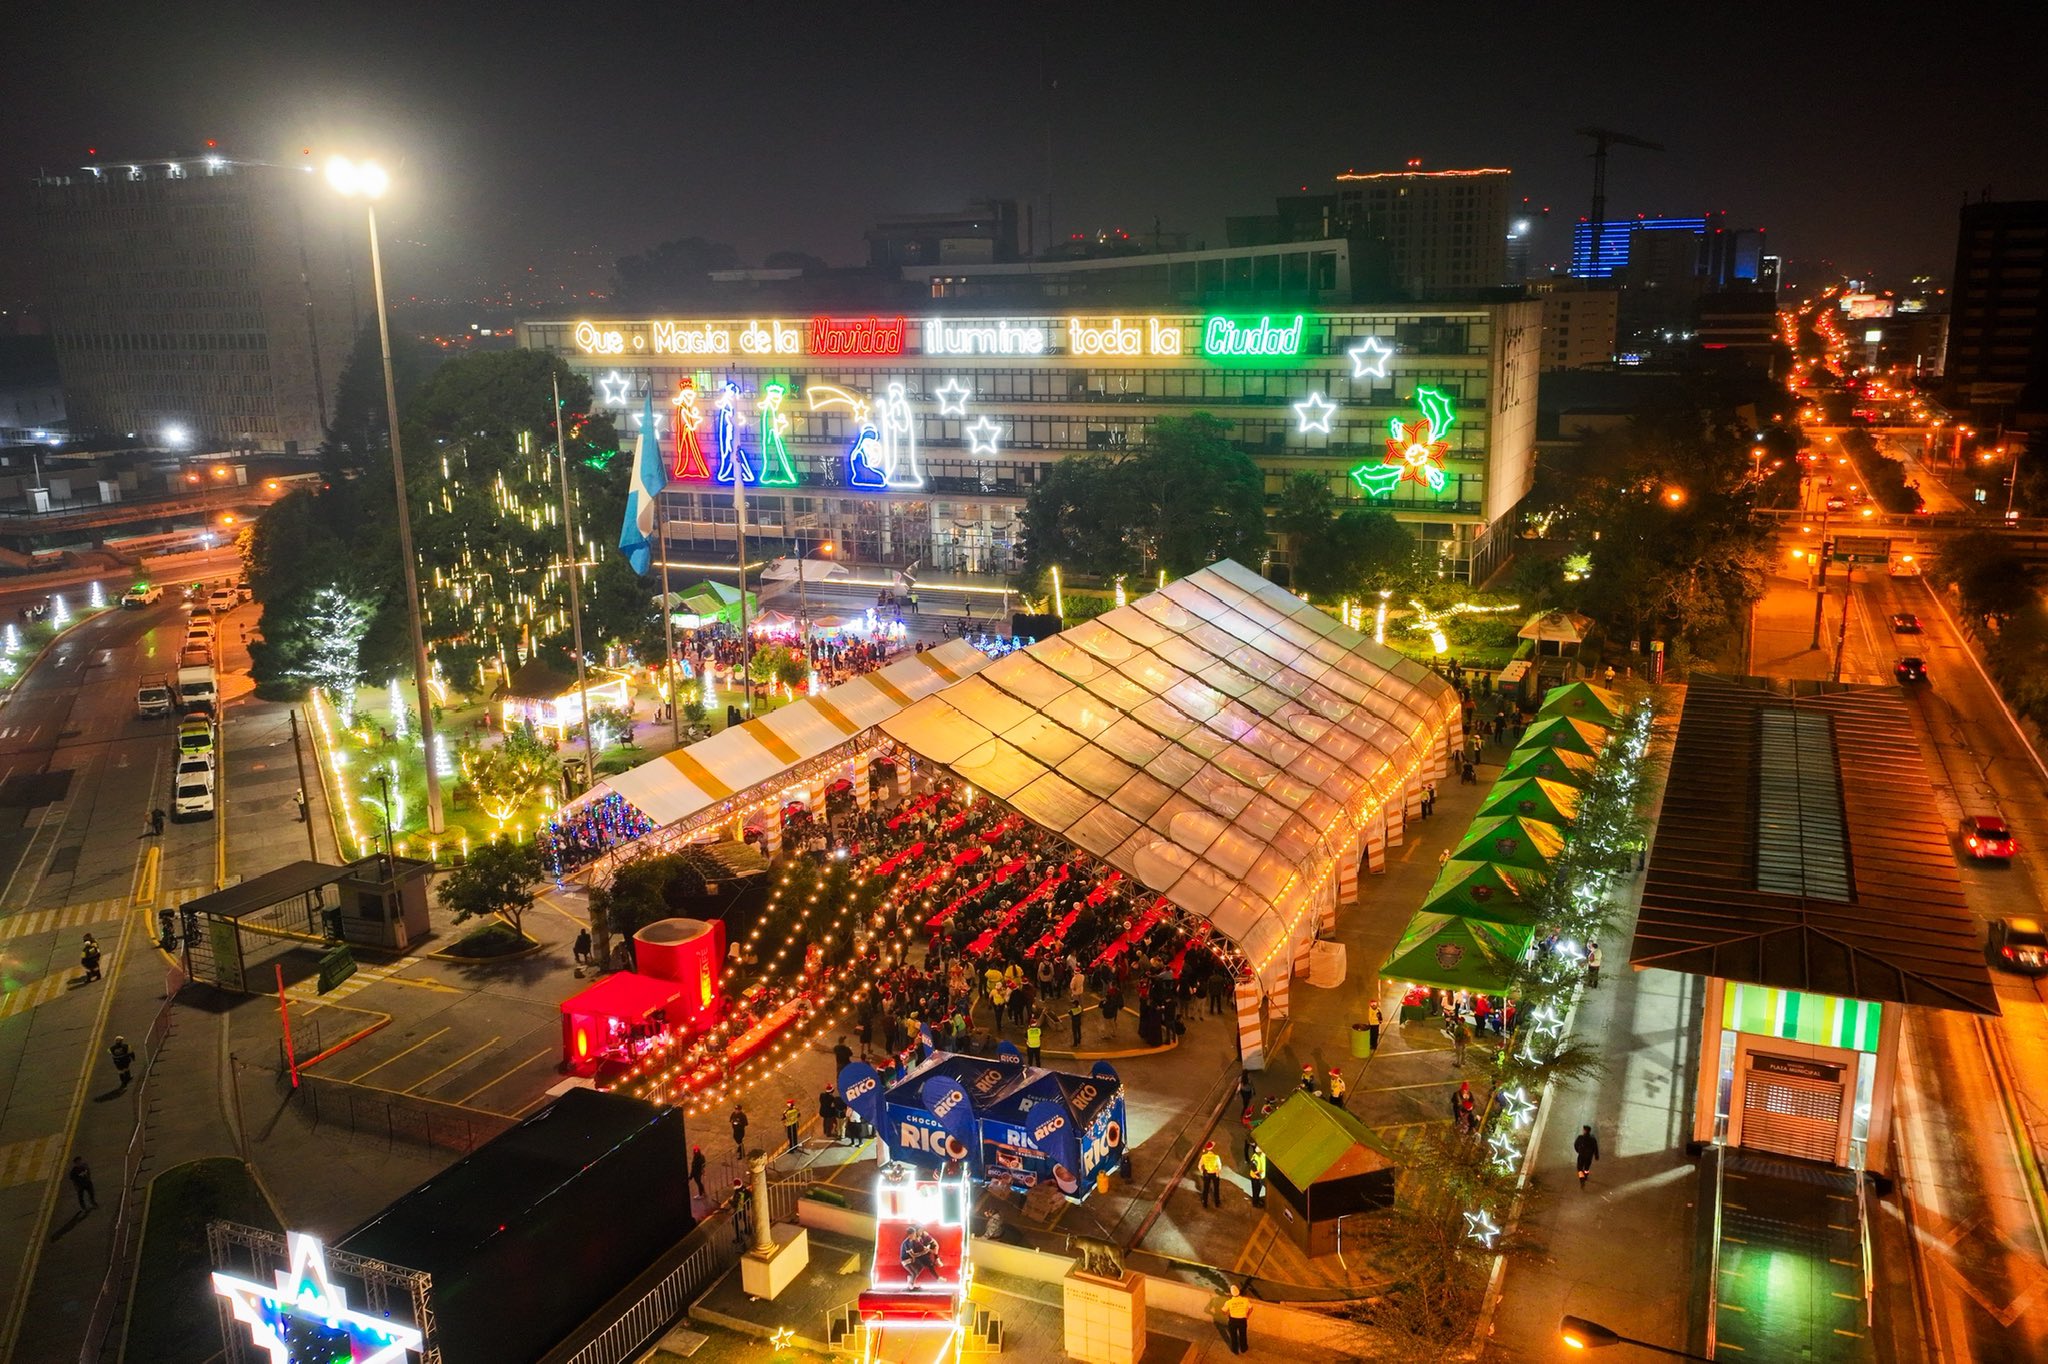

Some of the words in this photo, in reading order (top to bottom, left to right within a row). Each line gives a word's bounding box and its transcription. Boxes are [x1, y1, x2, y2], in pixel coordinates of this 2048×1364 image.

[575, 321, 625, 354] Que
[653, 320, 730, 354] Magia
[739, 319, 773, 354] de
[773, 319, 800, 354] la
[811, 317, 904, 355] Navidad
[926, 317, 1044, 355] ilumine
[1068, 317, 1142, 355] toda
[1149, 316, 1181, 355] la
[1204, 314, 1304, 356] Ciudad
[975, 1070, 1002, 1093] RICO
[1769, 1064, 1788, 1072] PLAZA
[1788, 1068, 1821, 1077] MUNICIPAL
[846, 1079, 876, 1102] RICO
[1071, 1084, 1098, 1111] RICO
[934, 1090, 963, 1118] RICO
[1034, 1117, 1065, 1141] RICO
[1084, 1121, 1120, 1177] RICO
